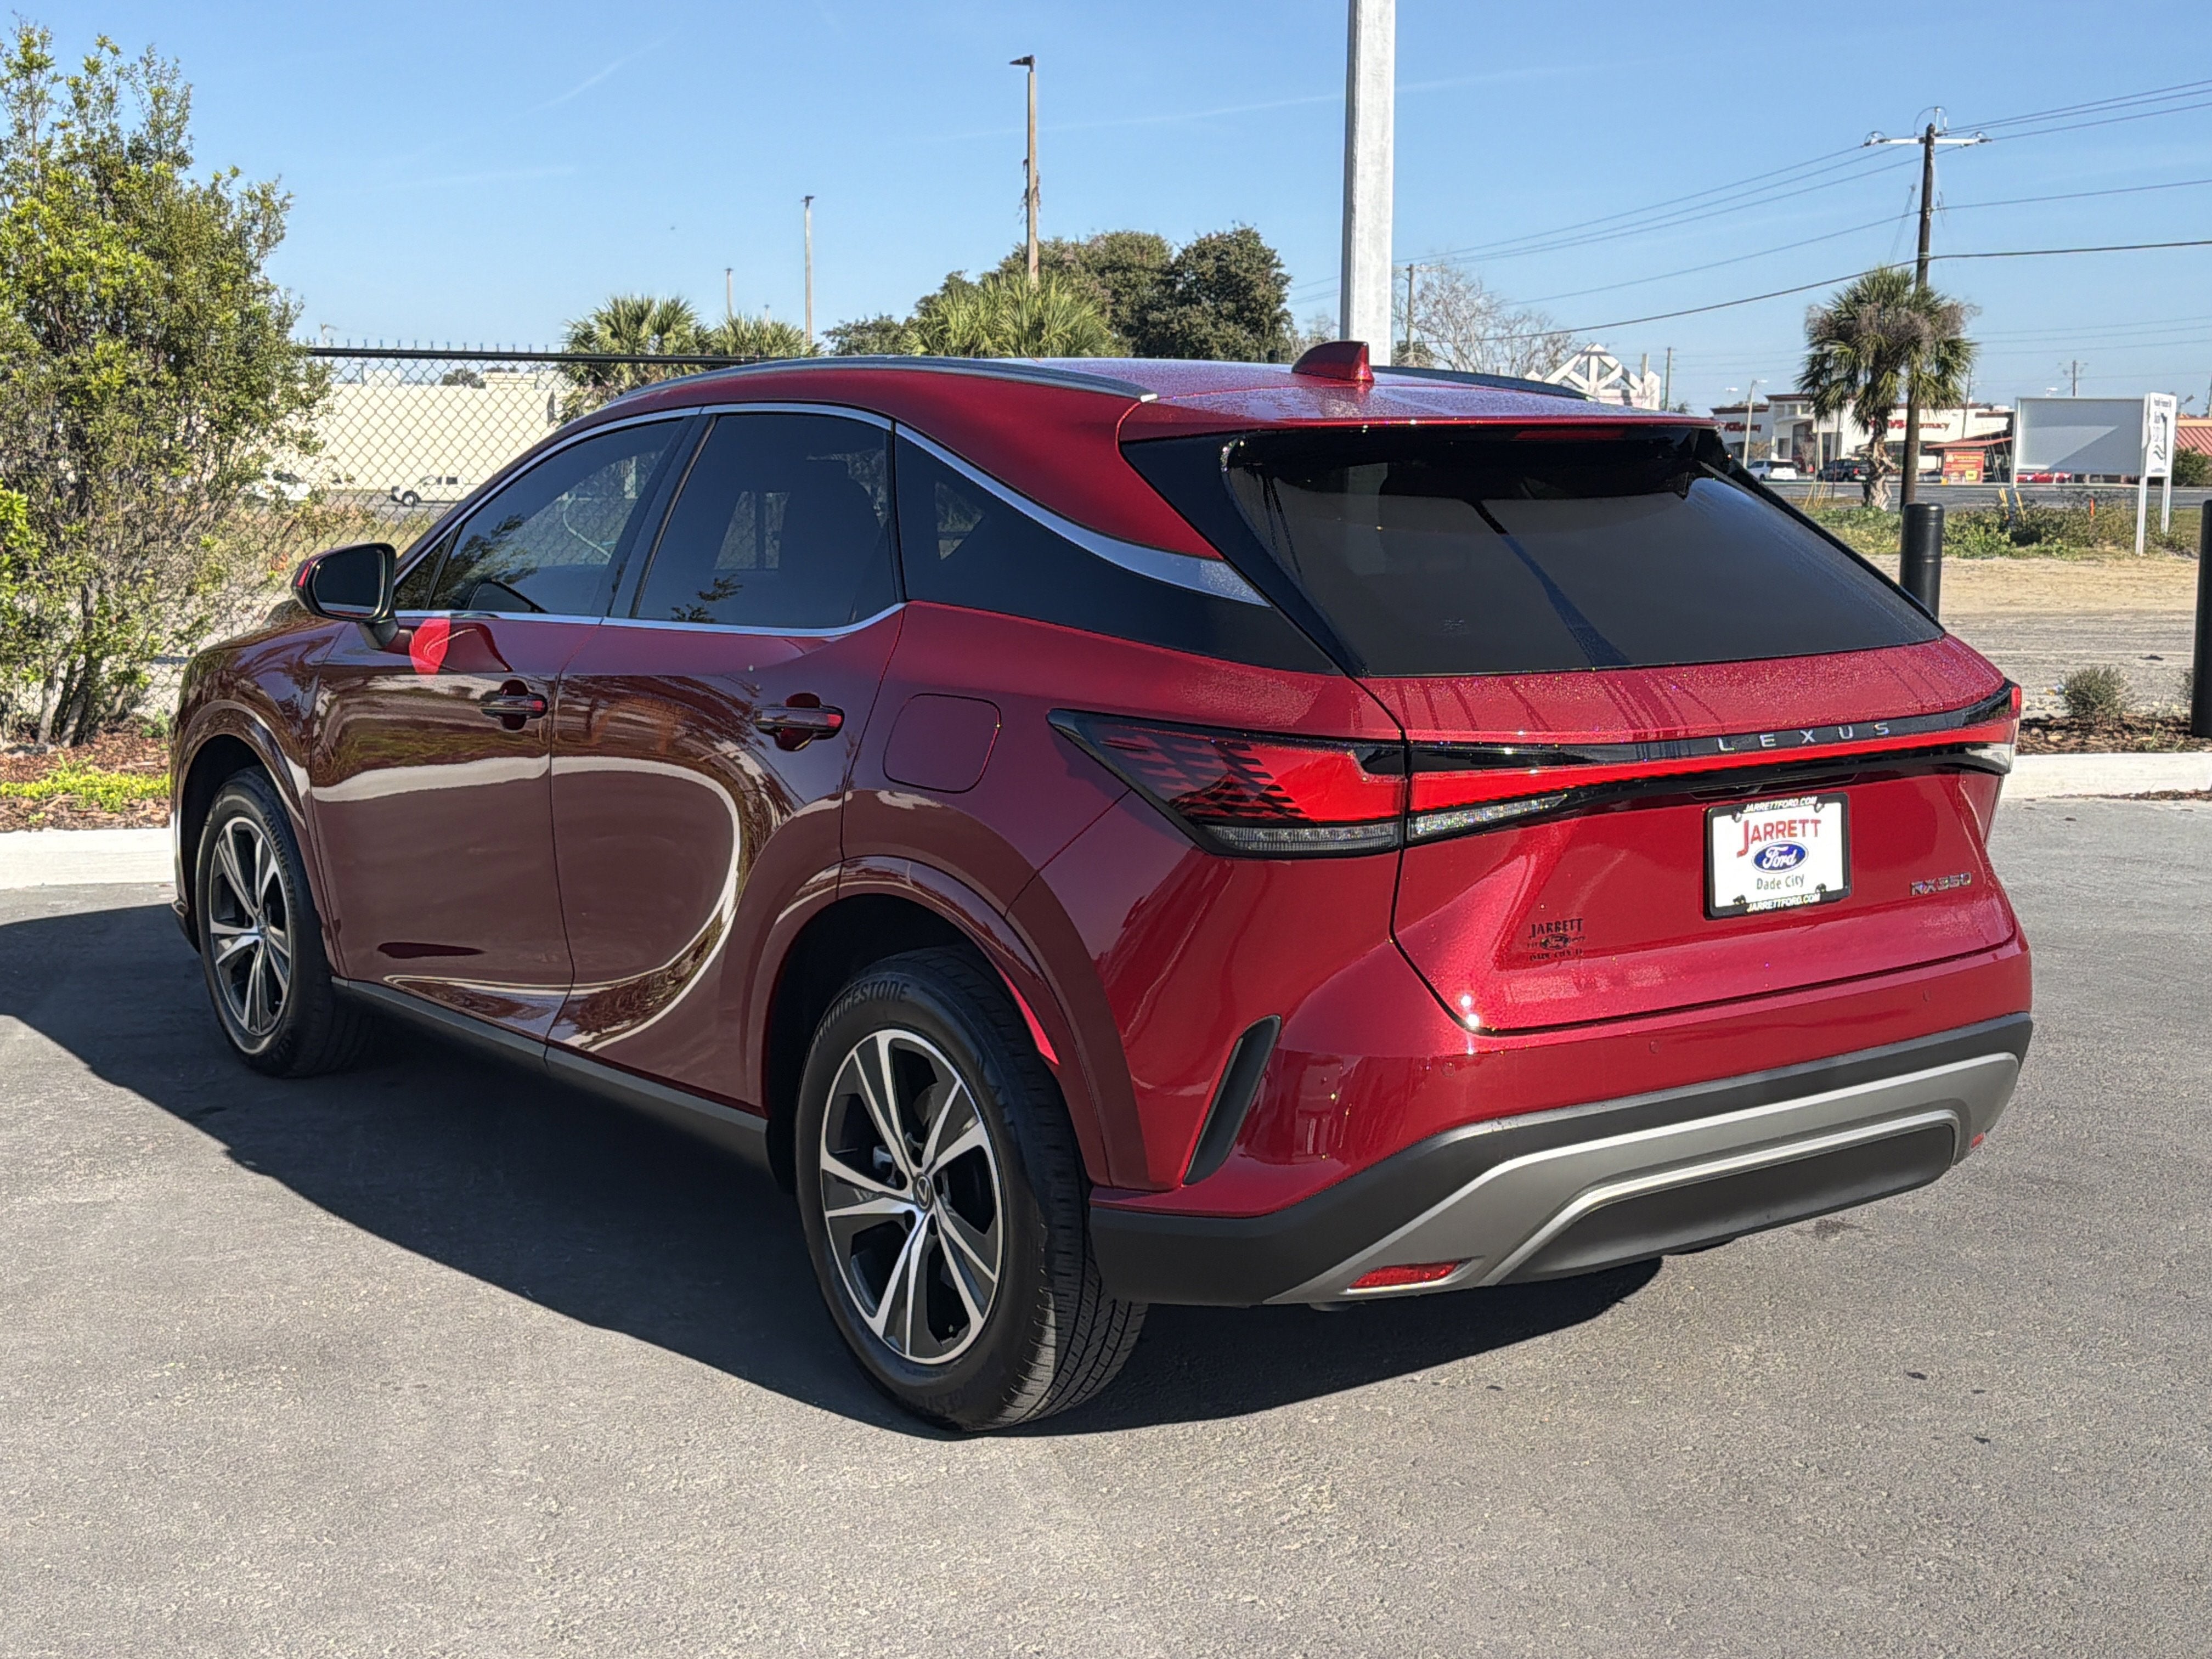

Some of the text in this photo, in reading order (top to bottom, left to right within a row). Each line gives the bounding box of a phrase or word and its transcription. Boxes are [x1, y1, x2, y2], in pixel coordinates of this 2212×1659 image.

[1718, 722, 1889, 752] LEXUS
[1743, 795, 1818, 813] JARRETTFORD.COM
[1736, 819, 1821, 857] JARRETT
[1762, 845, 1798, 869] Ford
[1756, 873, 1804, 890] Dade City
[1746, 893, 1820, 913] JARRETTFORD.COM
[1527, 918, 1584, 939] JARRETT
